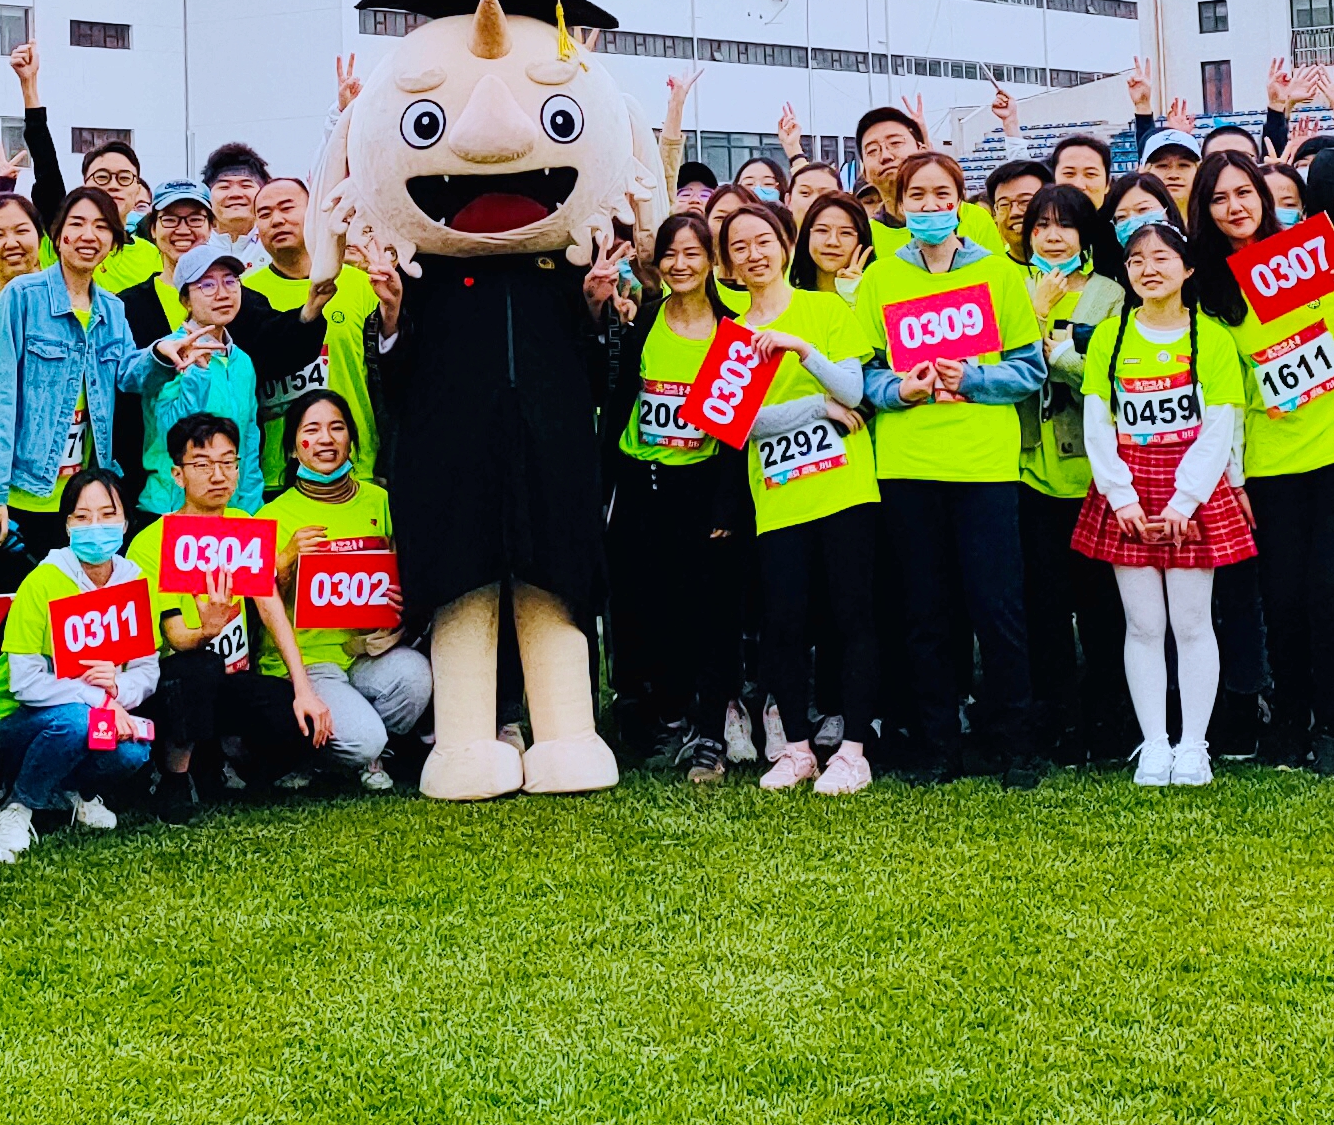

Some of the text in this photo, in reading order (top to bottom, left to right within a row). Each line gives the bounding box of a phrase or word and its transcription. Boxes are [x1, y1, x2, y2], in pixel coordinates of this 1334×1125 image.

[1251, 236, 1329, 297] 0307
[899, 303, 984, 349] 0309
[702, 341, 761, 425] 0303
[1262, 345, 1333, 397] 1611
[1123, 394, 1195, 426] 0459
[759, 424, 833, 470] 2292
[174, 535, 263, 574] 0304
[310, 572, 390, 607] 0302
[64, 600, 138, 653] 0311
